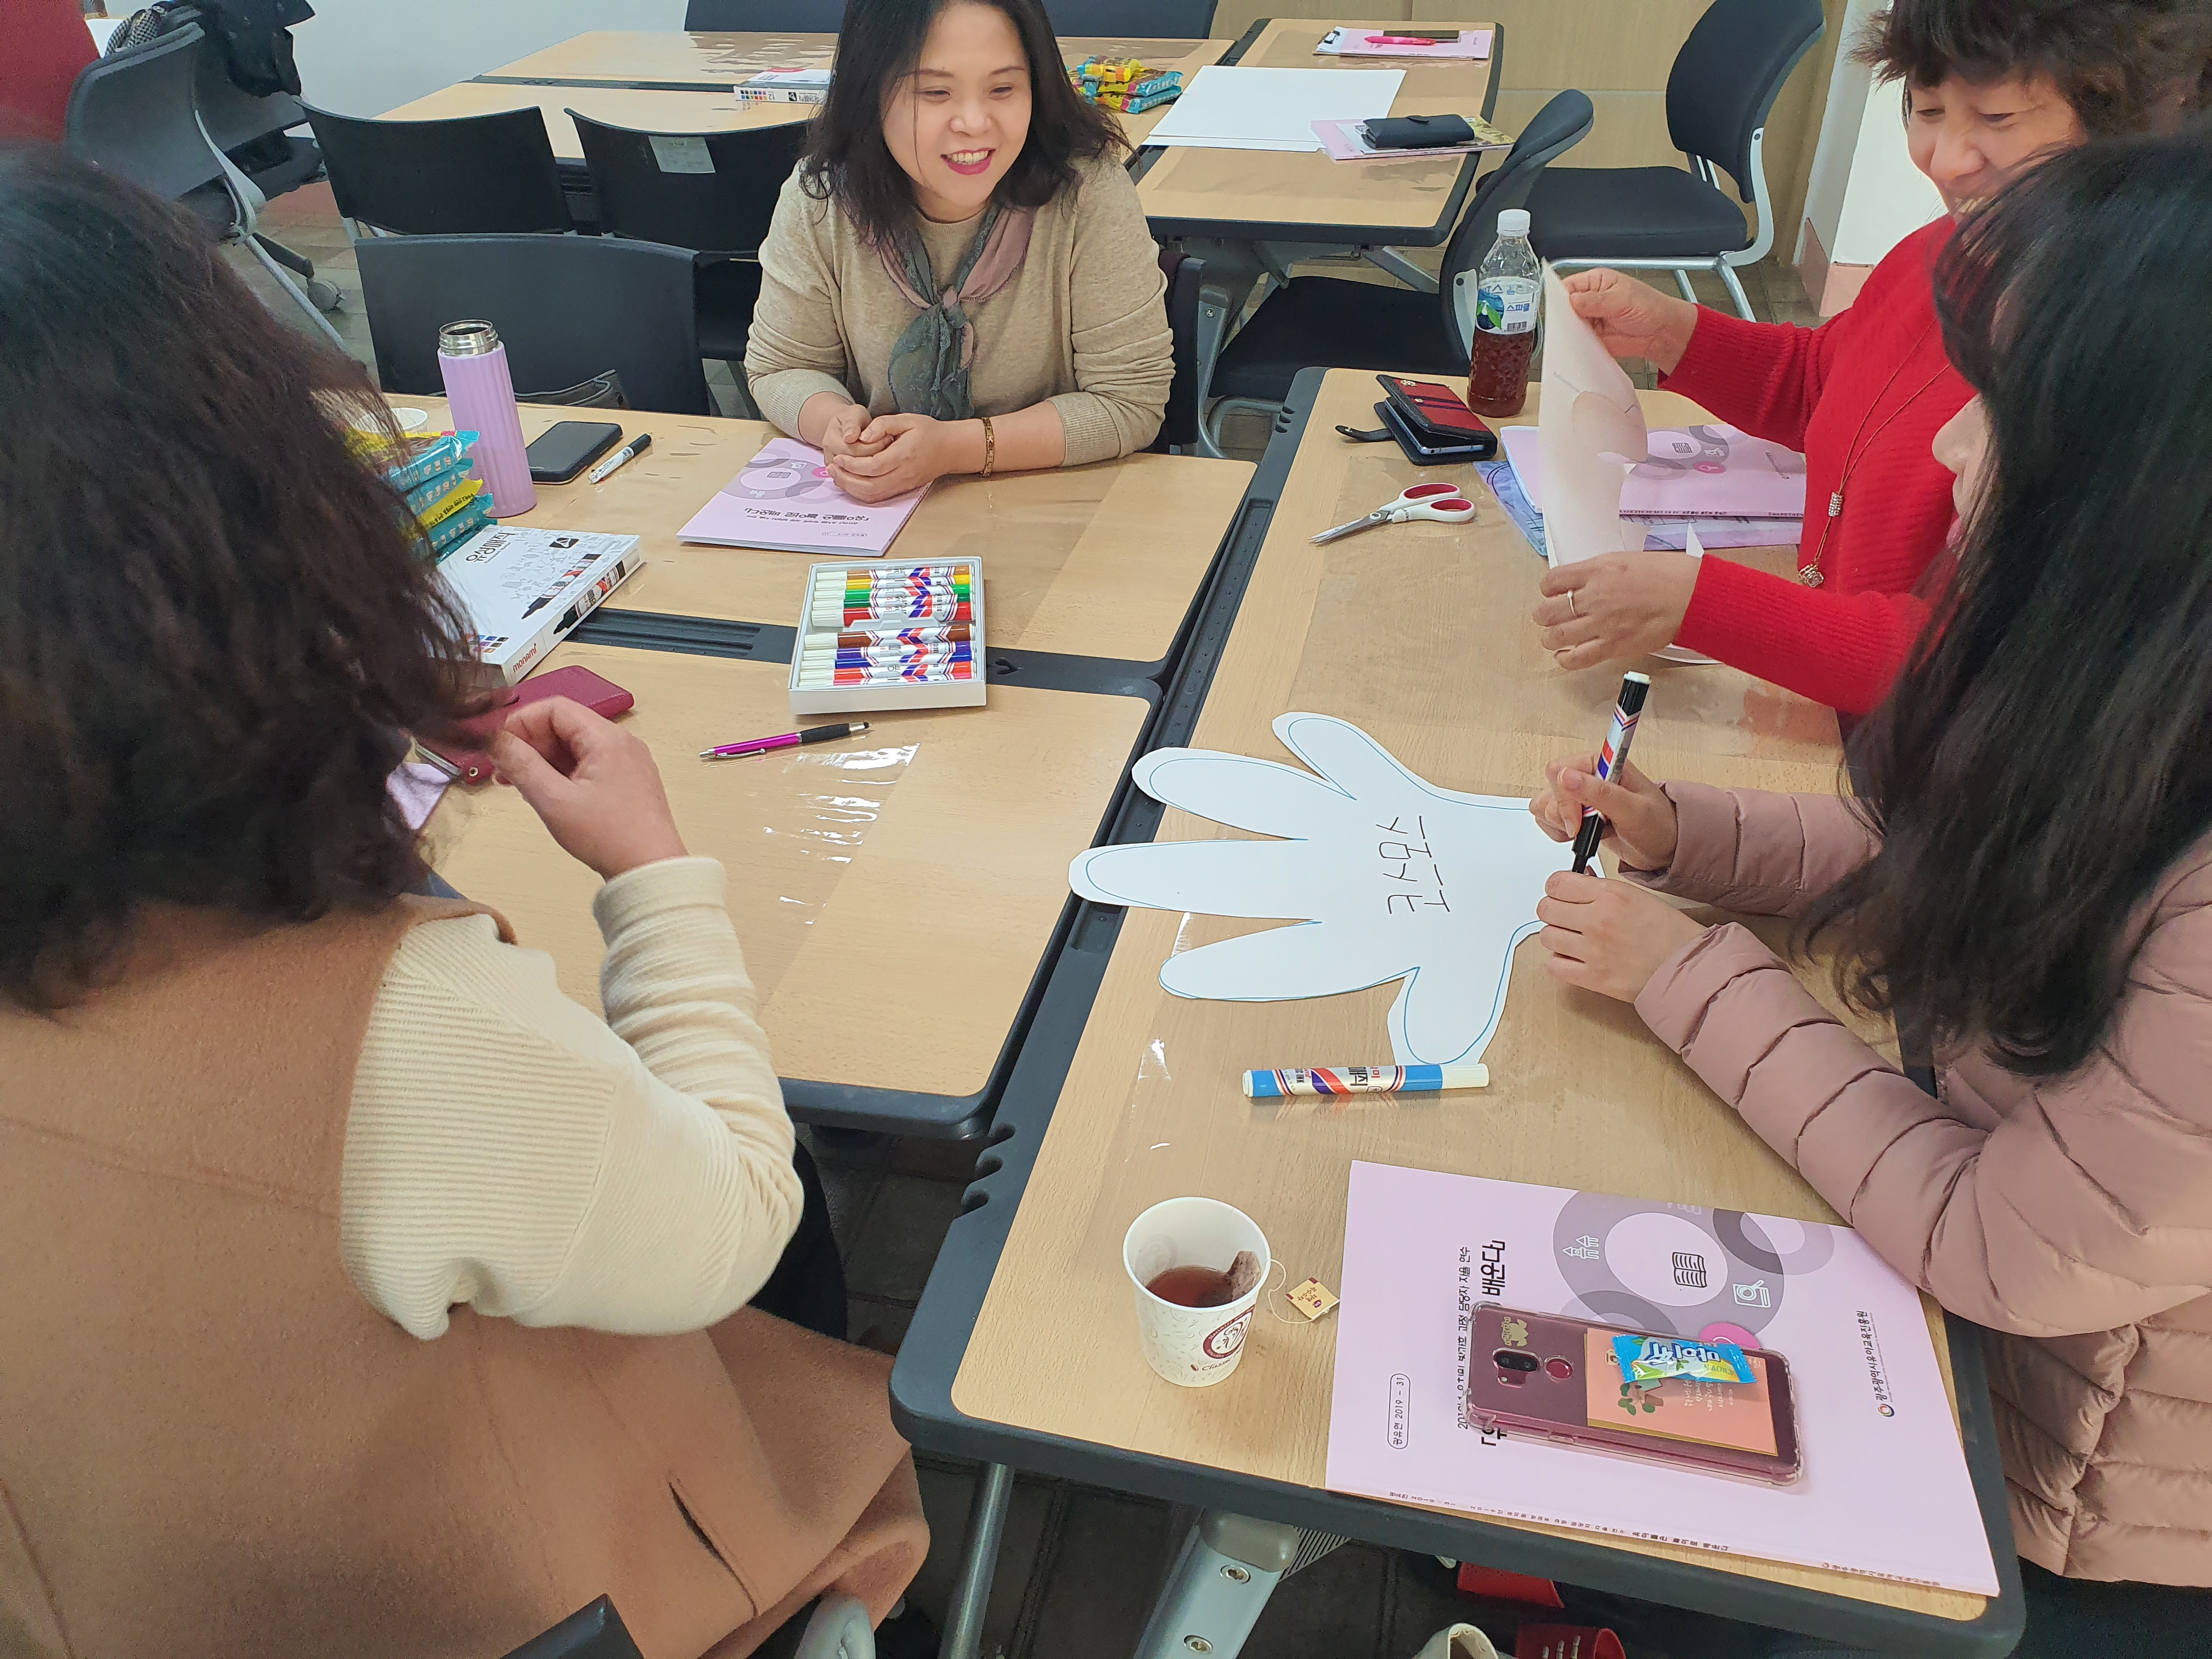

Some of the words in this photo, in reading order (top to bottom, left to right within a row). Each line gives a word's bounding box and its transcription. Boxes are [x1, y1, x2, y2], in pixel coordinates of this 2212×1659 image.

[1505, 303, 1530, 312] 스파클
[465, 532, 516, 562] 유성매직
[1374, 815, 1451, 915] 코스모스
[1459, 1246, 1470, 1263] 연수
[1458, 1266, 1470, 1283] 자율
[1458, 1285, 1469, 1312] 담당자
[1396, 1376, 1404, 1386] 31
[1395, 1399, 1403, 1419] 2019
[1392, 1422, 1403, 1446] 광유연
